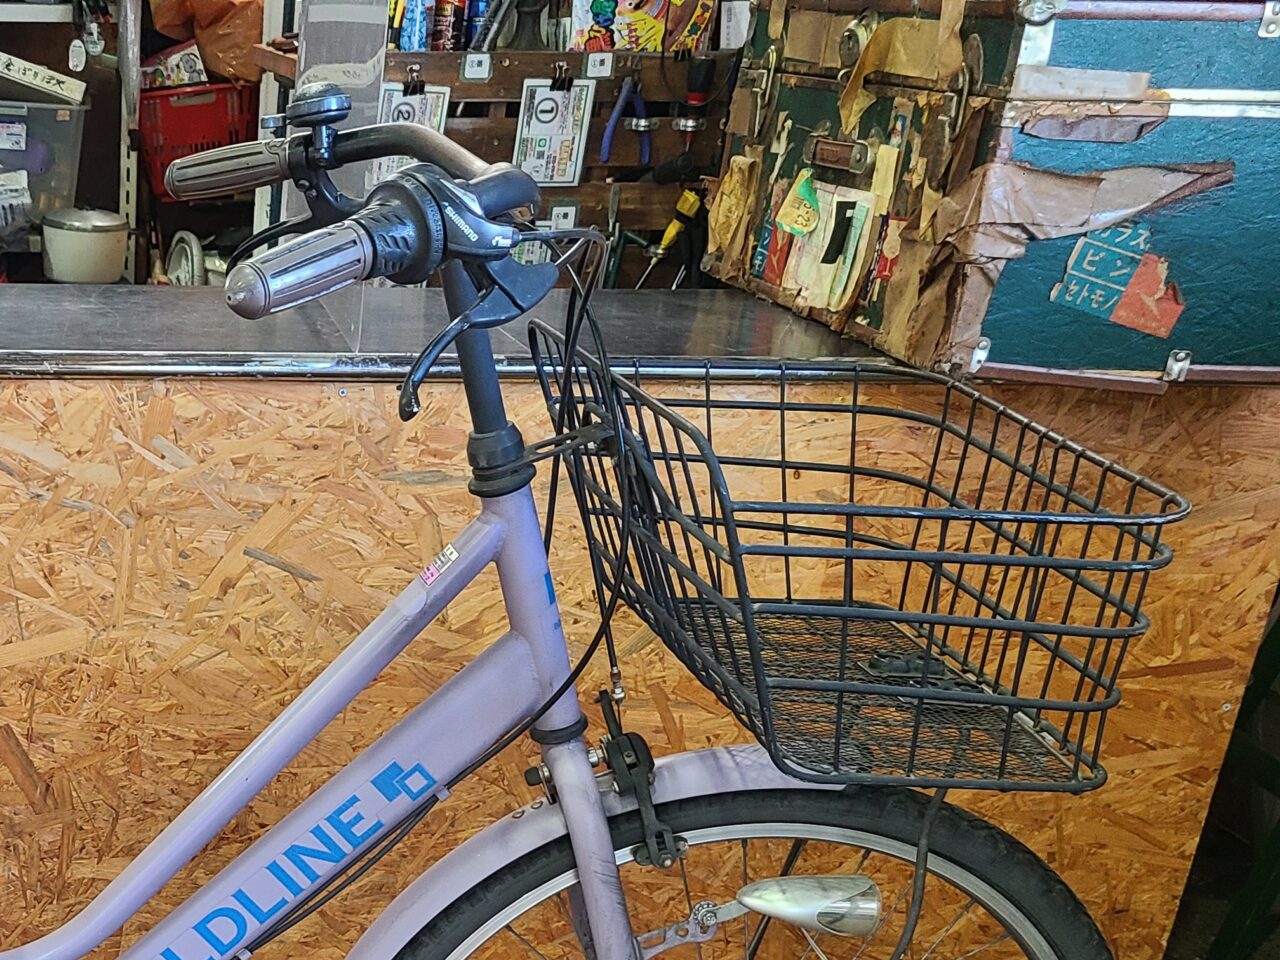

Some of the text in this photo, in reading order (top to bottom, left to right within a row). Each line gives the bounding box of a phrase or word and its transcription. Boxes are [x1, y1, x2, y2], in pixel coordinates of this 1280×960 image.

[445, 207, 479, 242] SHIMANO
[1082, 249, 1130, 277] ビン
[1065, 279, 1119, 311] セトモノ
